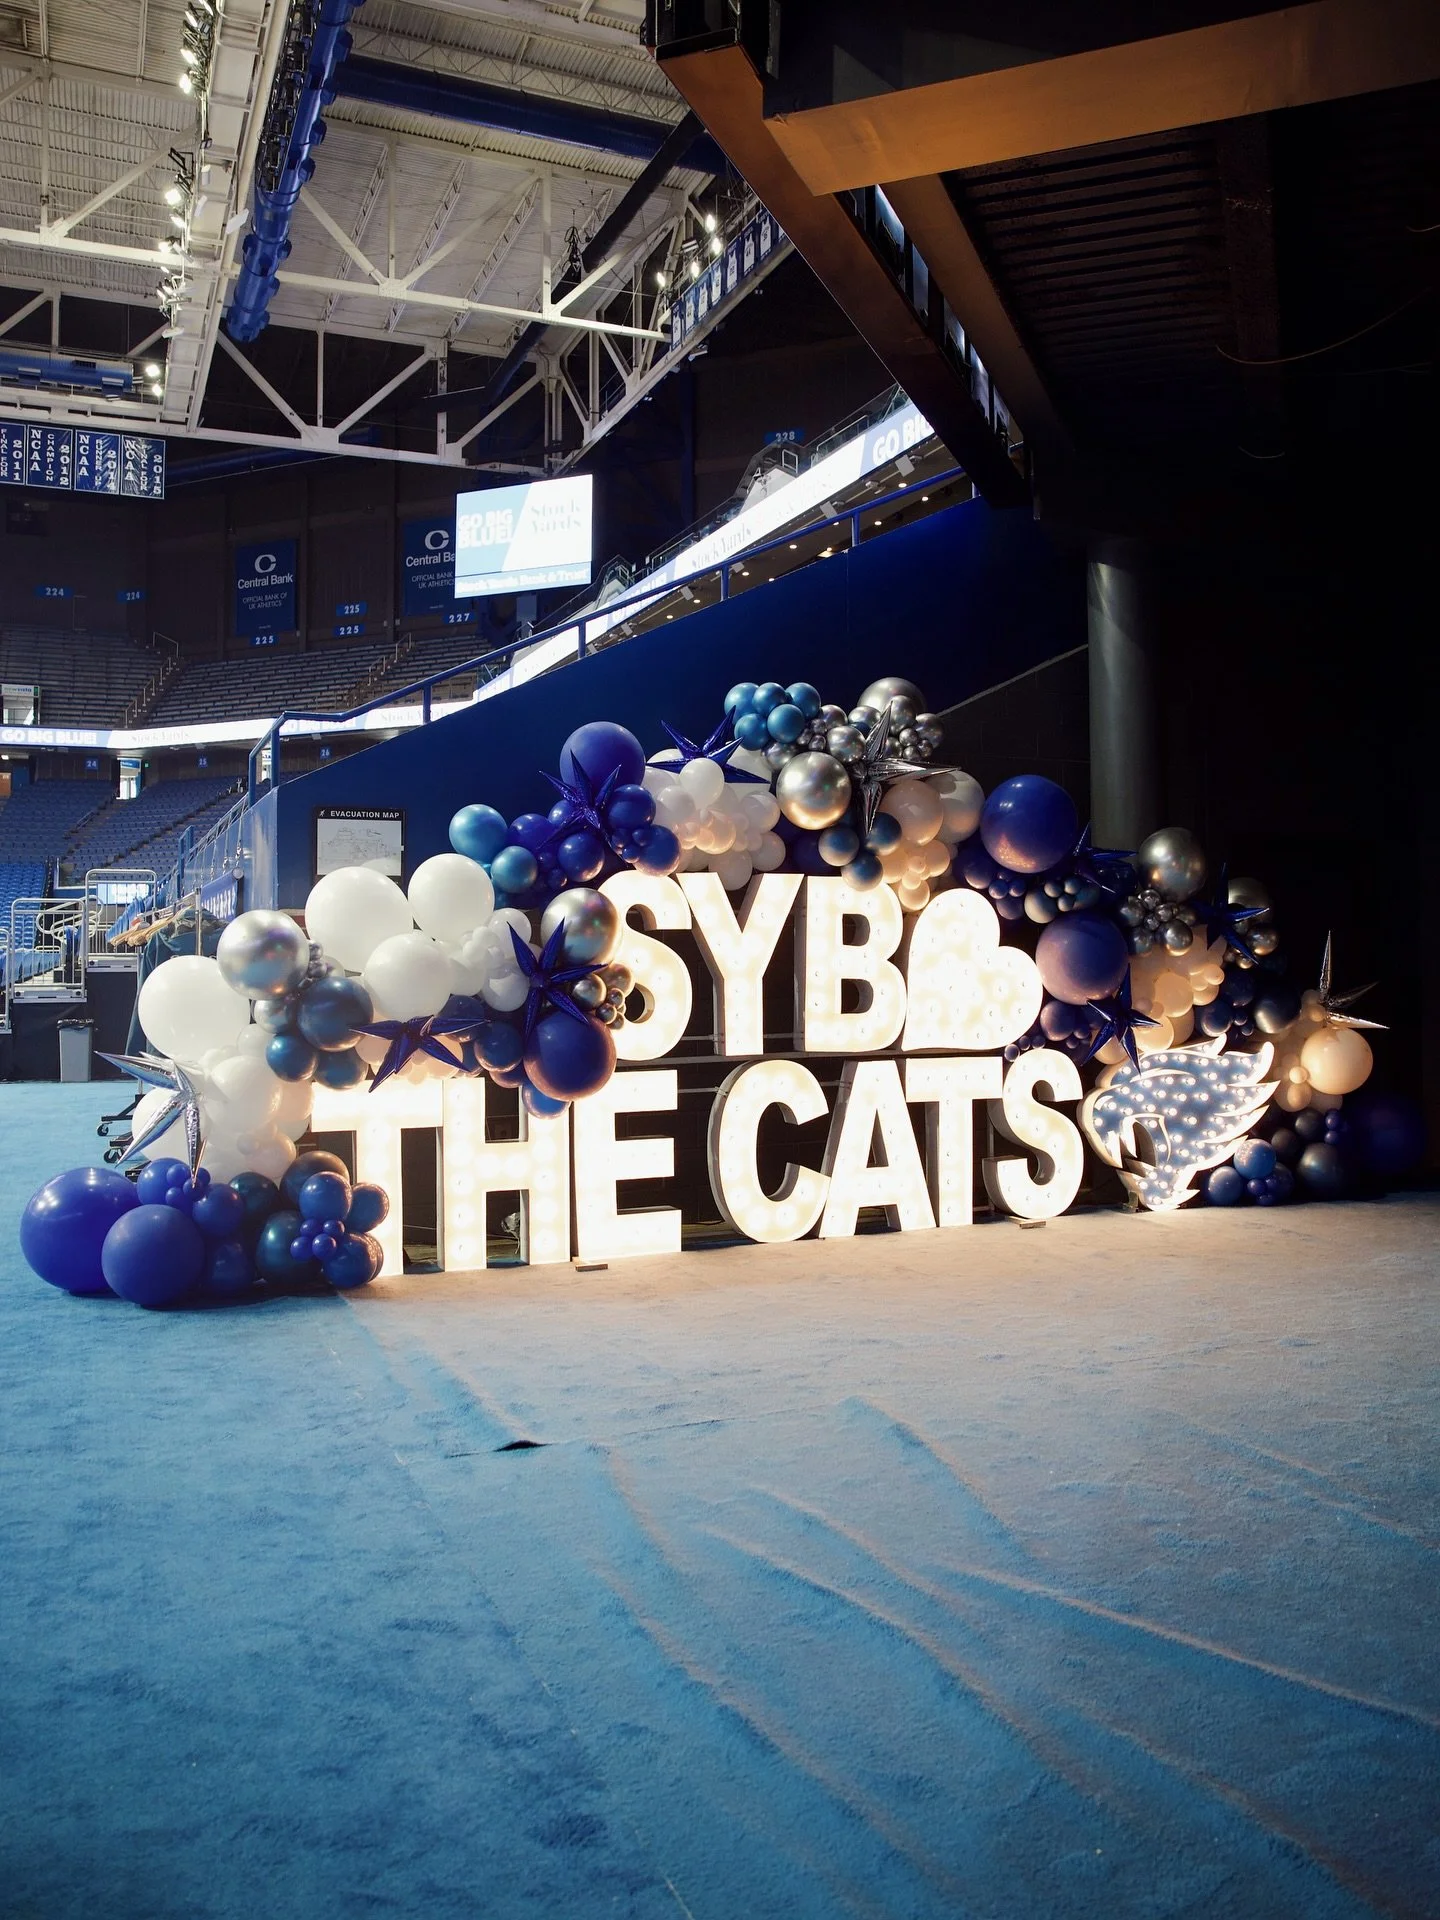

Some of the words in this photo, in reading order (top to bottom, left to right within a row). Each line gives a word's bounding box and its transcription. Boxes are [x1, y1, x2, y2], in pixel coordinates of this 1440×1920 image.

[30, 429, 42, 471] NCAA
[79, 434, 90, 476] NCAA
[95, 439, 103, 471] RUNNER
[872, 429, 900, 466] GO
[13, 439, 23, 481] 2011
[45, 433, 55, 482] CHAMPION
[60, 444, 70, 486] 2012
[124, 439, 136, 481] NCAA
[107, 449, 117, 491] 2014
[153, 454, 163, 495] 2015
[530, 498, 580, 517] Stock
[458, 513, 483, 528] GO
[485, 508, 513, 526] BIG
[530, 515, 582, 534] Yards
[406, 552, 441, 568] Central
[443, 551, 456, 563] Ba
[237, 576, 269, 589] Central
[270, 572, 293, 585] Bank
[411, 573, 436, 583] OFFICIAL
[436, 571, 454, 580] BANK
[45, 587, 65, 597] 224
[242, 595, 263, 604] OFFICIAL
[264, 593, 280, 602] BANK
[280, 591, 288, 600] OF
[257, 600, 282, 609] ATHLETICS
[344, 604, 360, 615] 225
[448, 613, 470, 624] 227
[255, 635, 274, 645] 225
[339, 625, 359, 636] 225
[1, 729, 26, 742] GO
[28, 730, 53, 743] BIG
[86, 760, 97, 768] 24
[330, 810, 380, 818] EVACUATION
[382, 811, 400, 819] MAP
[596, 871, 908, 1062] SYB
[311, 1068, 682, 1276] THE
[707, 1047, 1084, 1244] CATS
